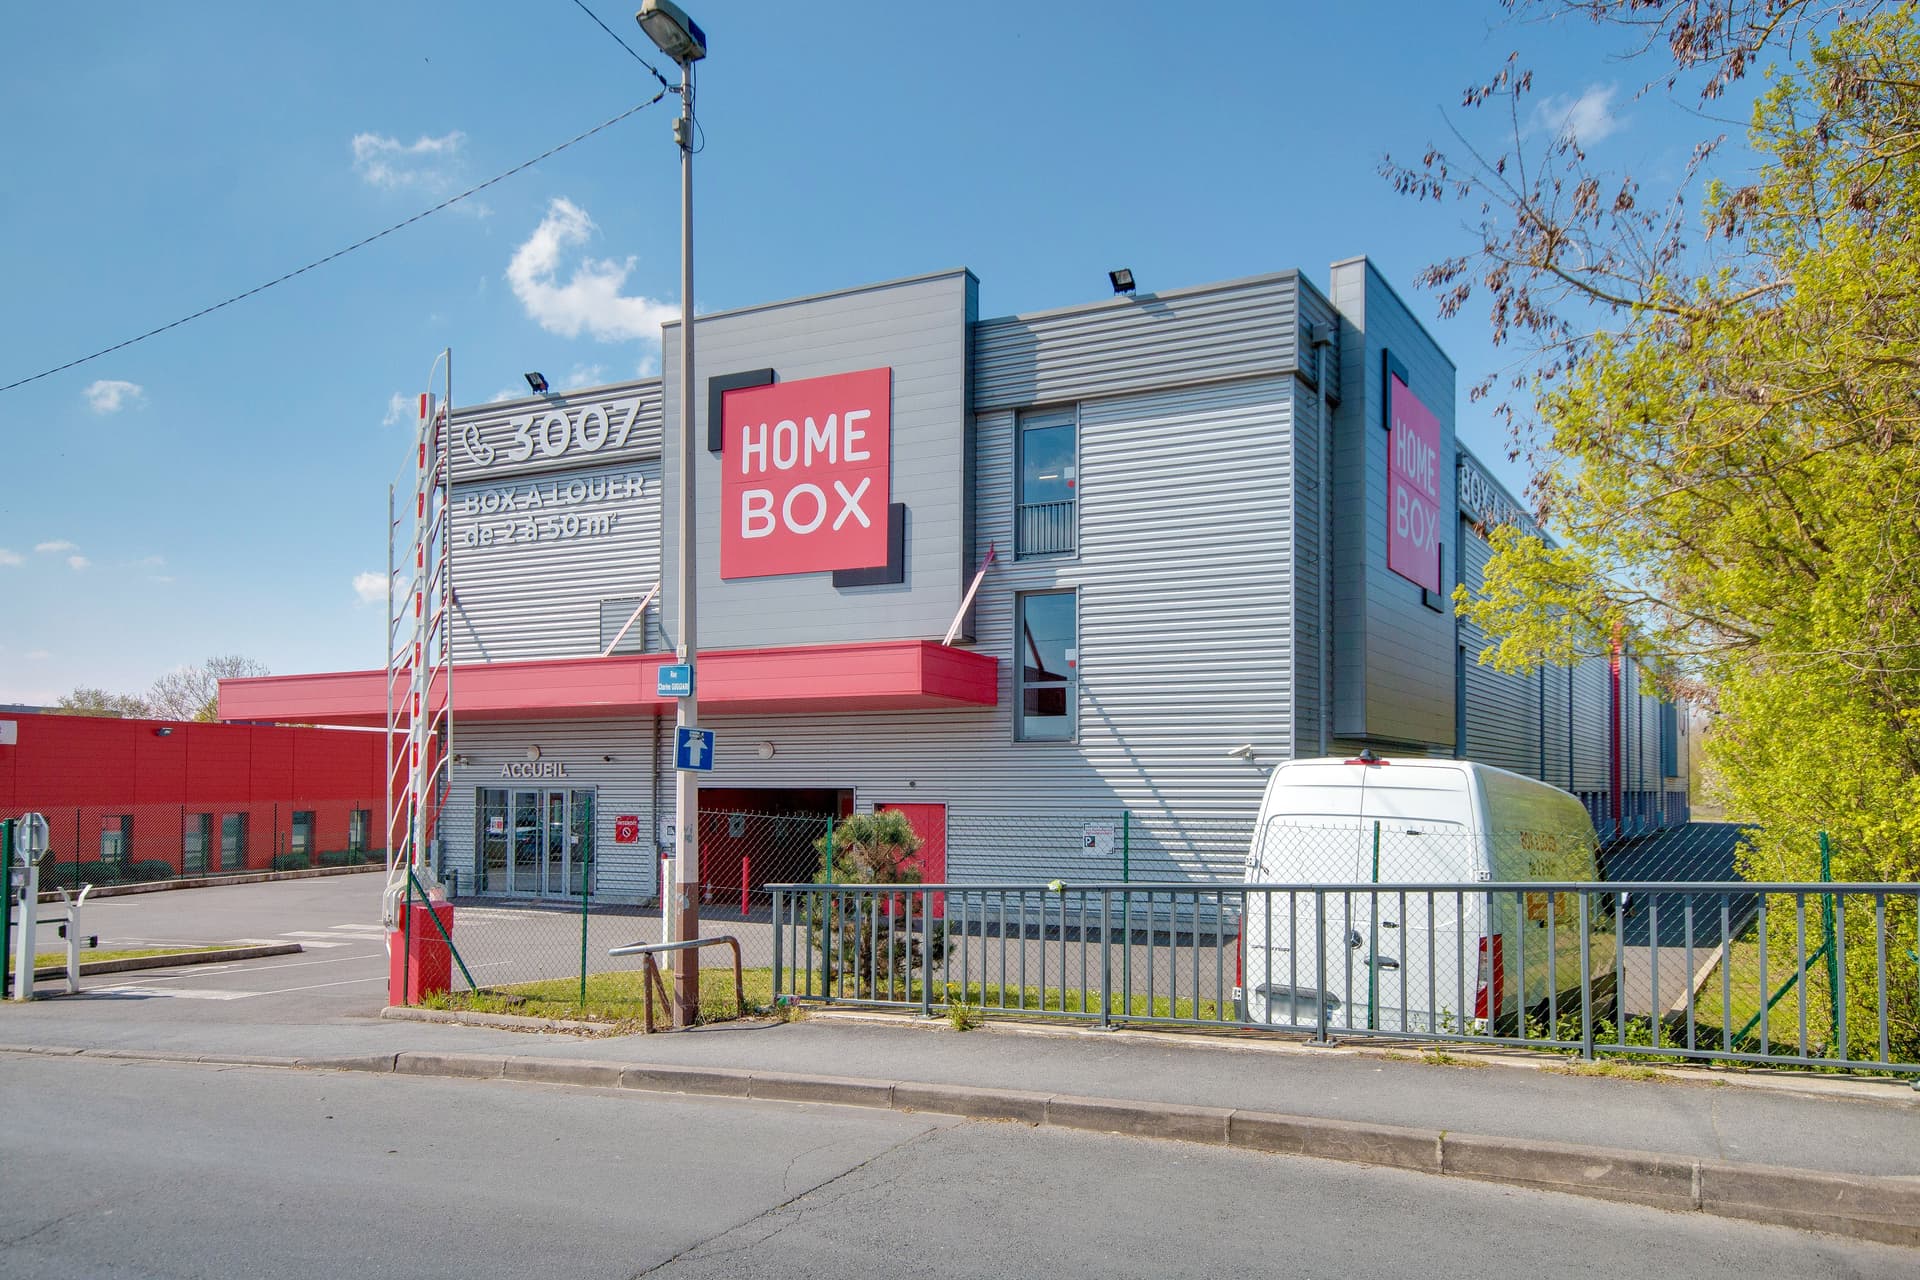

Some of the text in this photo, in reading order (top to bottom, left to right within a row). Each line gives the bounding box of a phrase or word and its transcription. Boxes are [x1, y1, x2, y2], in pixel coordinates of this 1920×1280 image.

[508, 399, 641, 461] 3007
[742, 409, 871, 475] HOME
[1396, 417, 1436, 497] HOME
[464, 486, 518, 515] BOX
[551, 472, 645, 504] LOUER
[741, 477, 871, 539] BOX
[1396, 486, 1436, 555] BOX
[464, 511, 618, 547] de 2 à 50 m²
[501, 762, 568, 778] ACCUEIL
